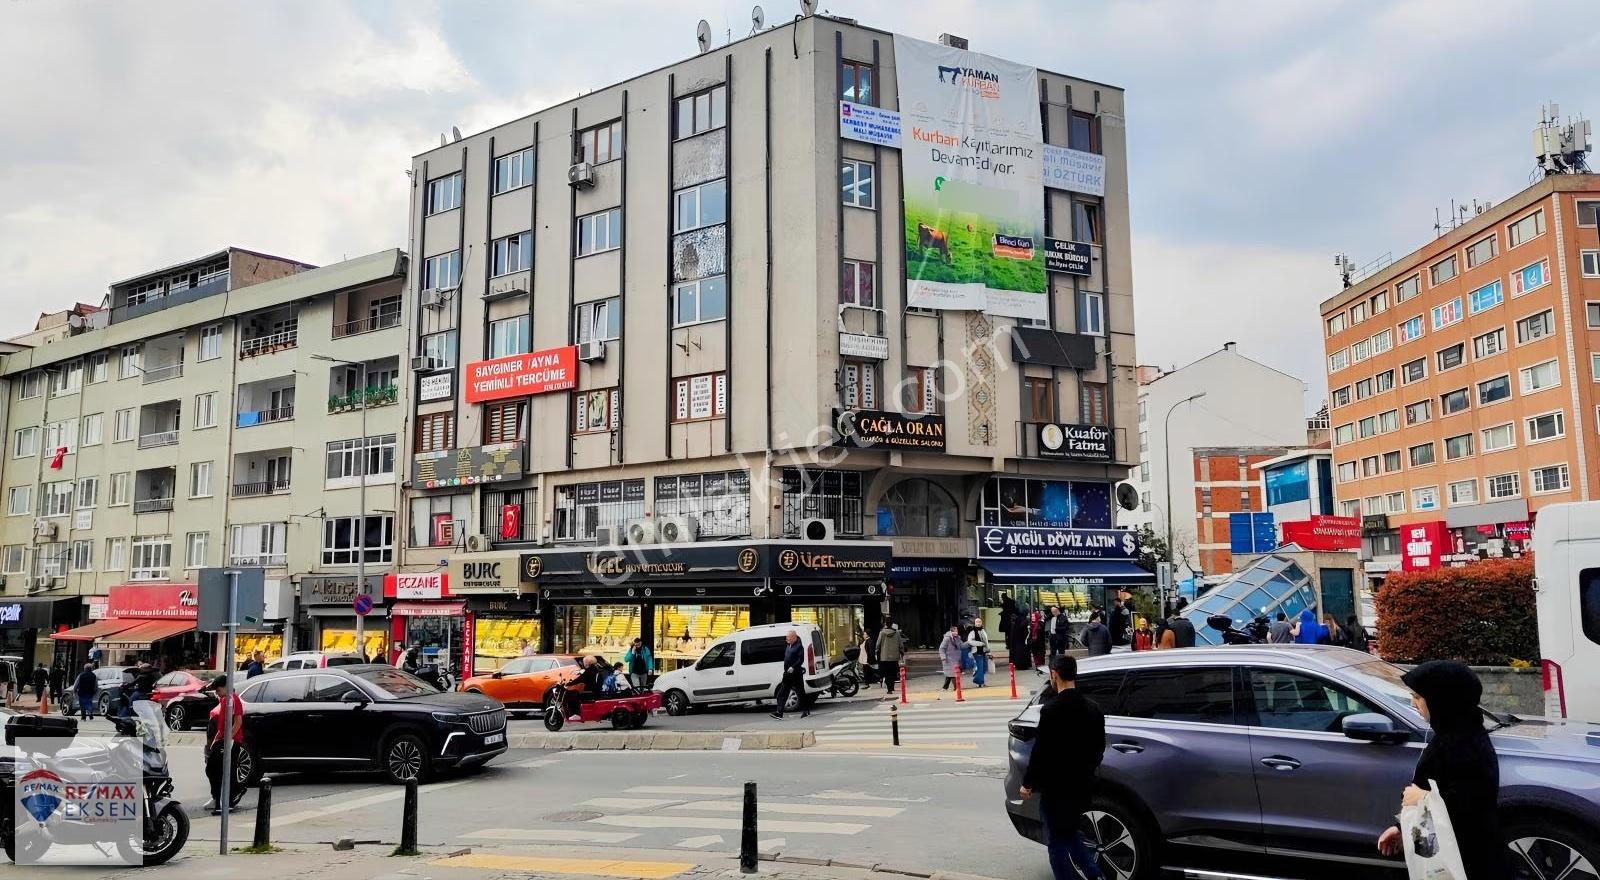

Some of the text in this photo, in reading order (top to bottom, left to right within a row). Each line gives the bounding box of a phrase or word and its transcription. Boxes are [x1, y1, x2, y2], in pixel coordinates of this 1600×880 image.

[962, 68, 998, 83] YAMAN
[912, 127, 1033, 158] Kurban Kayıtlarımız
[1054, 241, 1076, 252] ÇELİK
[1064, 252, 1088, 264] BÜROSU
[476, 360, 522, 378] SAYGINER
[474, 374, 513, 392] YEMİNLİ
[516, 368, 566, 386] TERCÜME
[860, 416, 943, 436] ÇAĞLA ORAN
[1065, 427, 1108, 440] Kuaför
[1070, 439, 1106, 451] Fatma
[1006, 530, 1045, 546] AKGÜL
[1048, 532, 1082, 546] DÖVİZ
[1086, 534, 1116, 548] ALTIN
[586, 553, 684, 576] ÜÇEL KUYUMCULUK
[800, 552, 886, 570] ÜÇEL KUYUMCULUK
[398, 576, 439, 588] ECZANE
[0, 604, 21, 624] çelik
